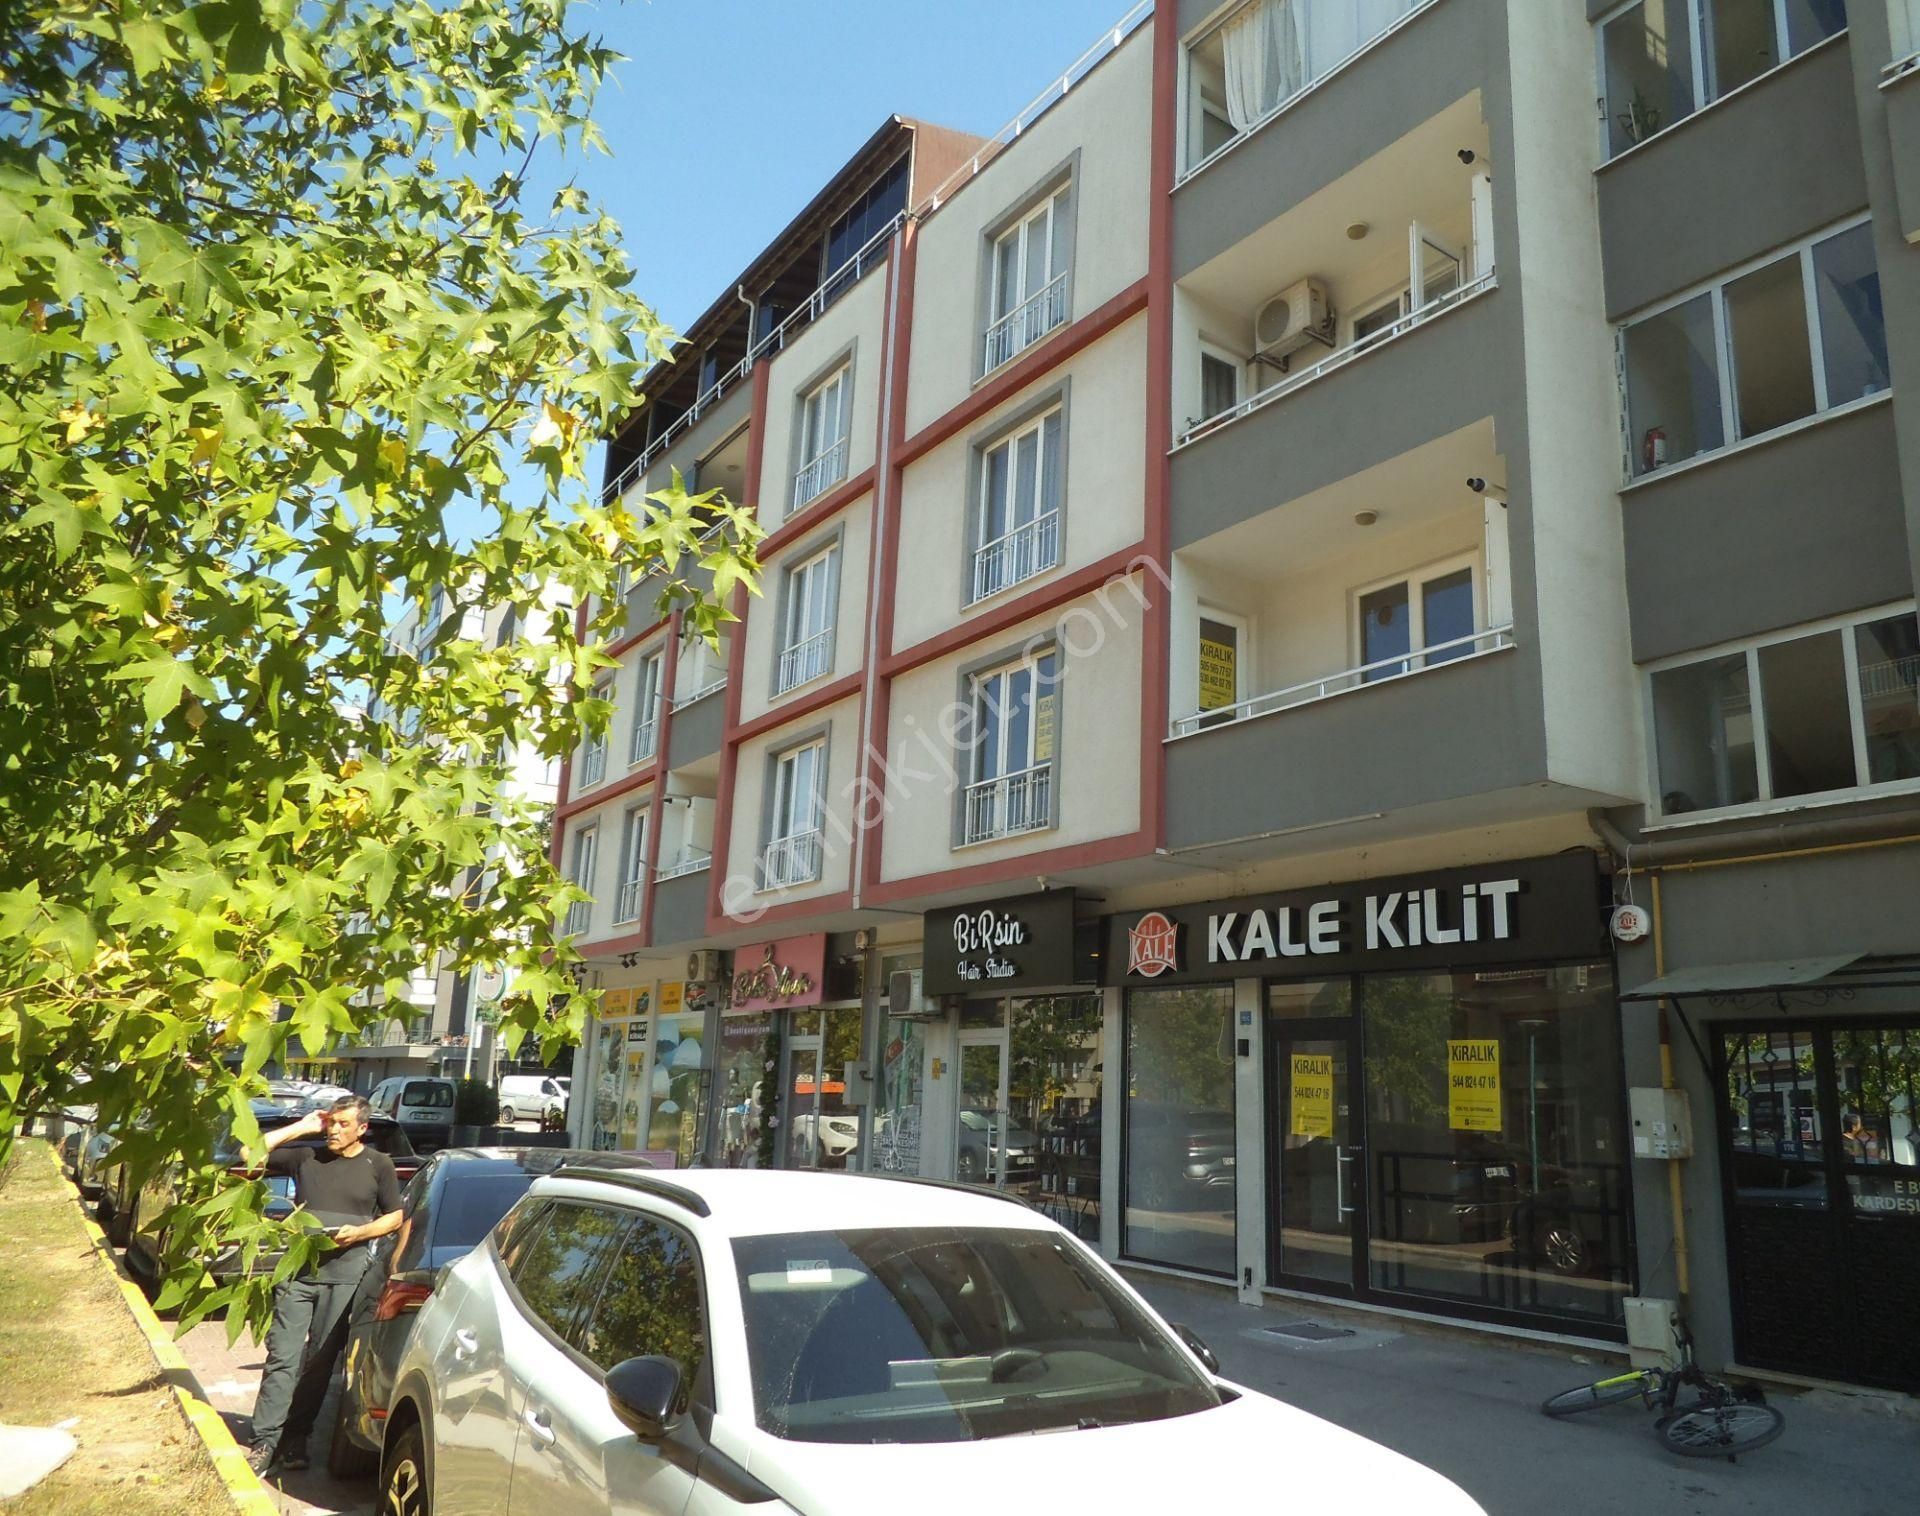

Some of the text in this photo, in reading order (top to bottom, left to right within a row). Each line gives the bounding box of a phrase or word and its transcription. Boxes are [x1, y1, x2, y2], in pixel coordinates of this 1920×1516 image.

[953, 909, 1024, 954] BiRsin
[1208, 900, 1340, 963] KALE
[1131, 928, 1175, 968] KALE
[957, 958, 1015, 980] Hair Studio
[1452, 1076, 1496, 1089] 544 824 47 16
[1894, 1180, 1920, 1195] E B
